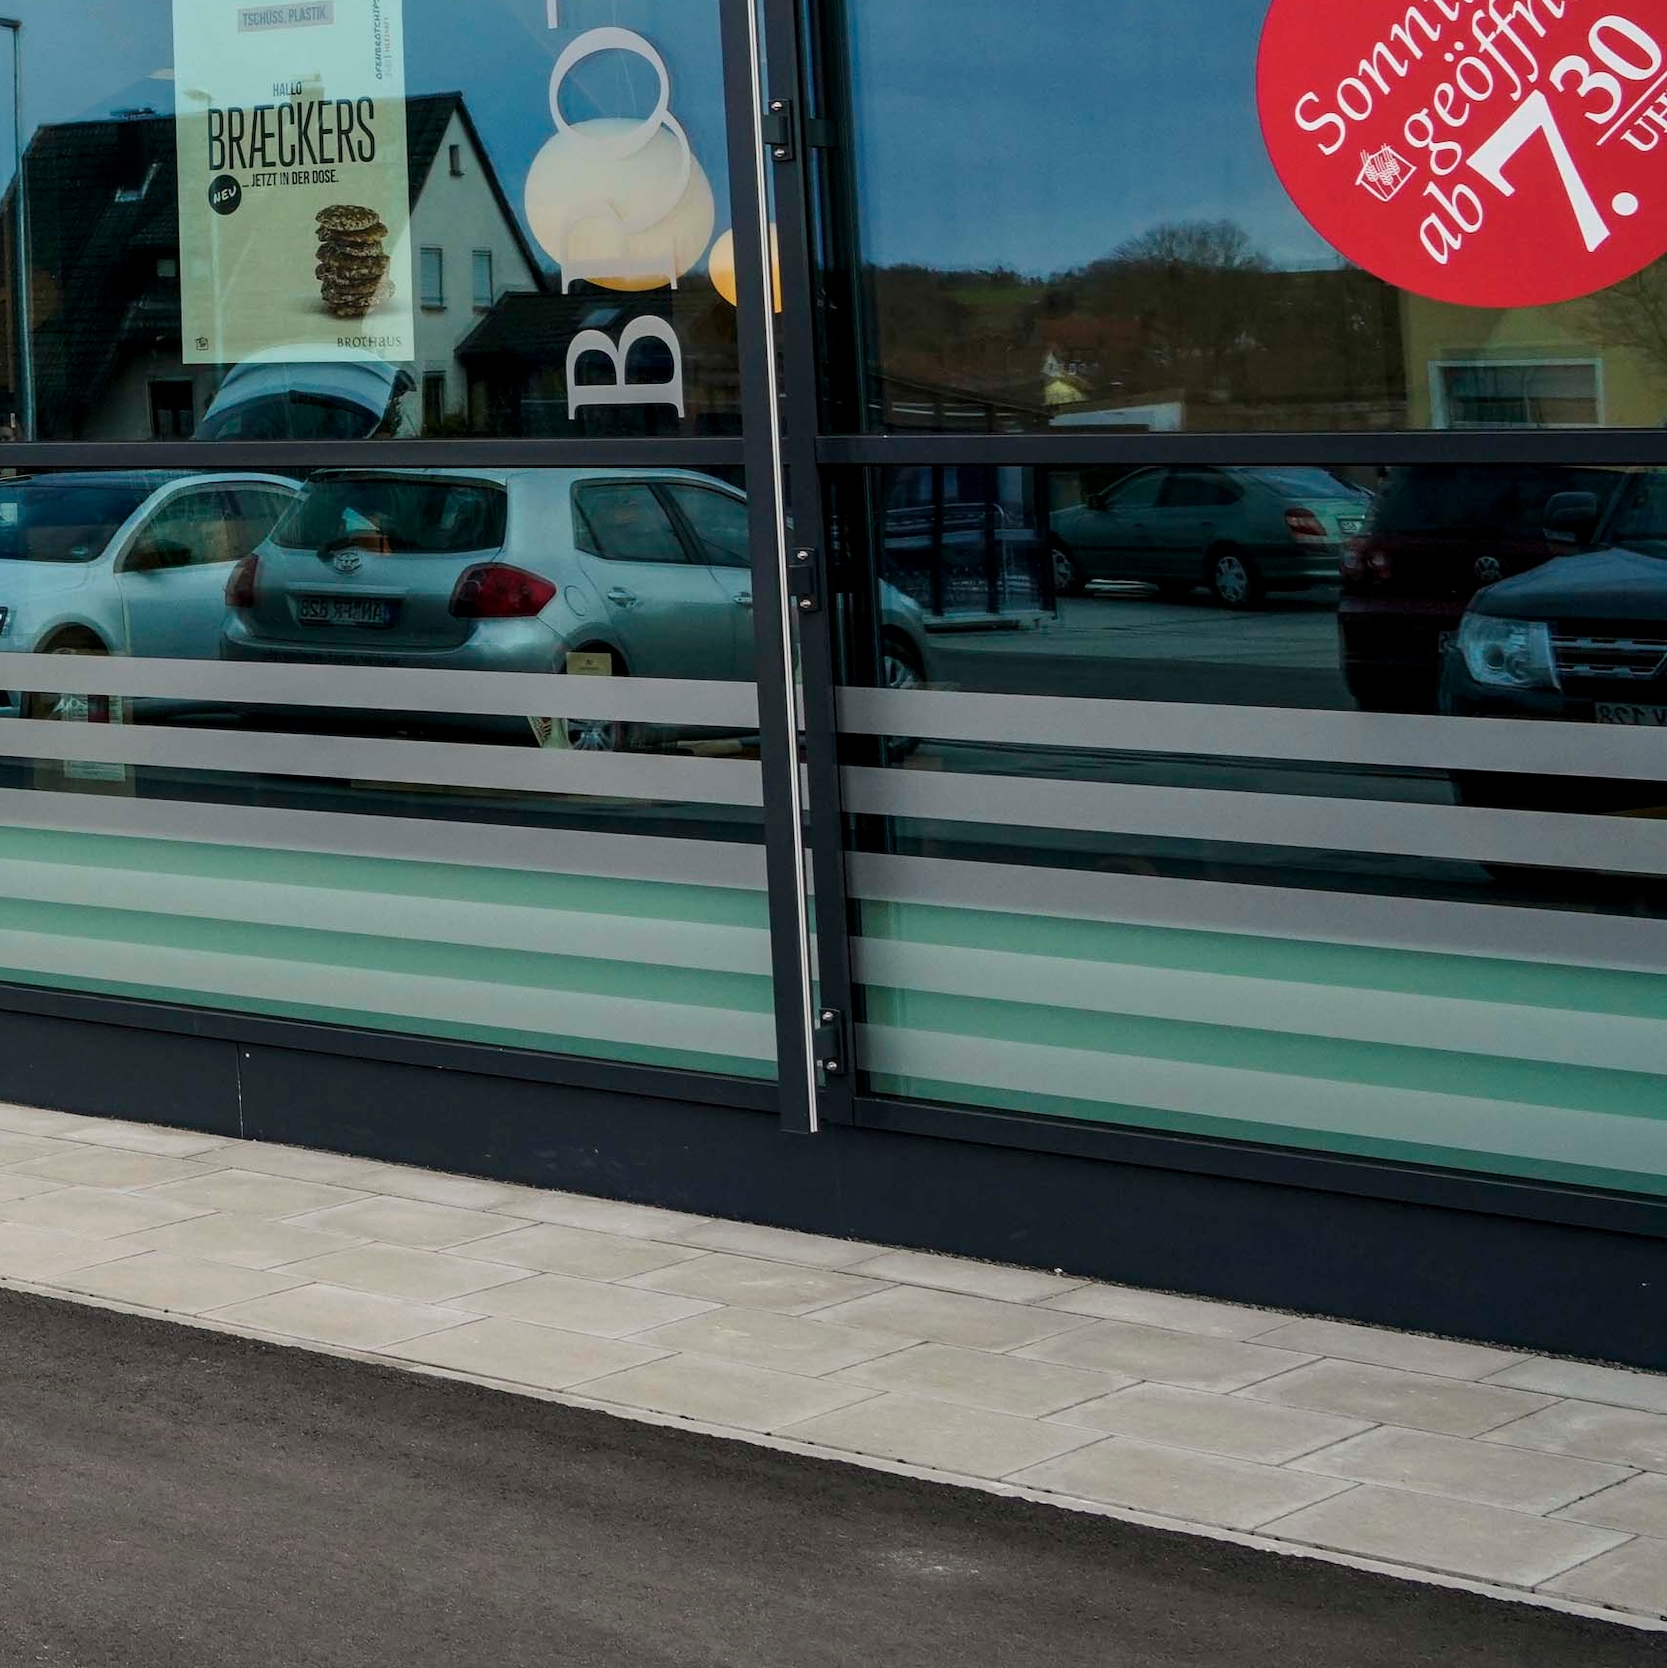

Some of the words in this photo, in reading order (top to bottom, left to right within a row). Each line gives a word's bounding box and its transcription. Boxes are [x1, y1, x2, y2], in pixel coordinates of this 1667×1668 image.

[273, 81, 302, 97] HALLO
[208, 96, 376, 172] BRÆCKERS
[1619, 89, 1667, 152] UH
[212, 185, 237, 205] NEU
[251, 173, 278, 188] JETZT
[280, 172, 289, 186] IN
[292, 171, 310, 185] DER
[312, 169, 339, 183] DOSE.
[1419, 181, 1484, 265] ab
